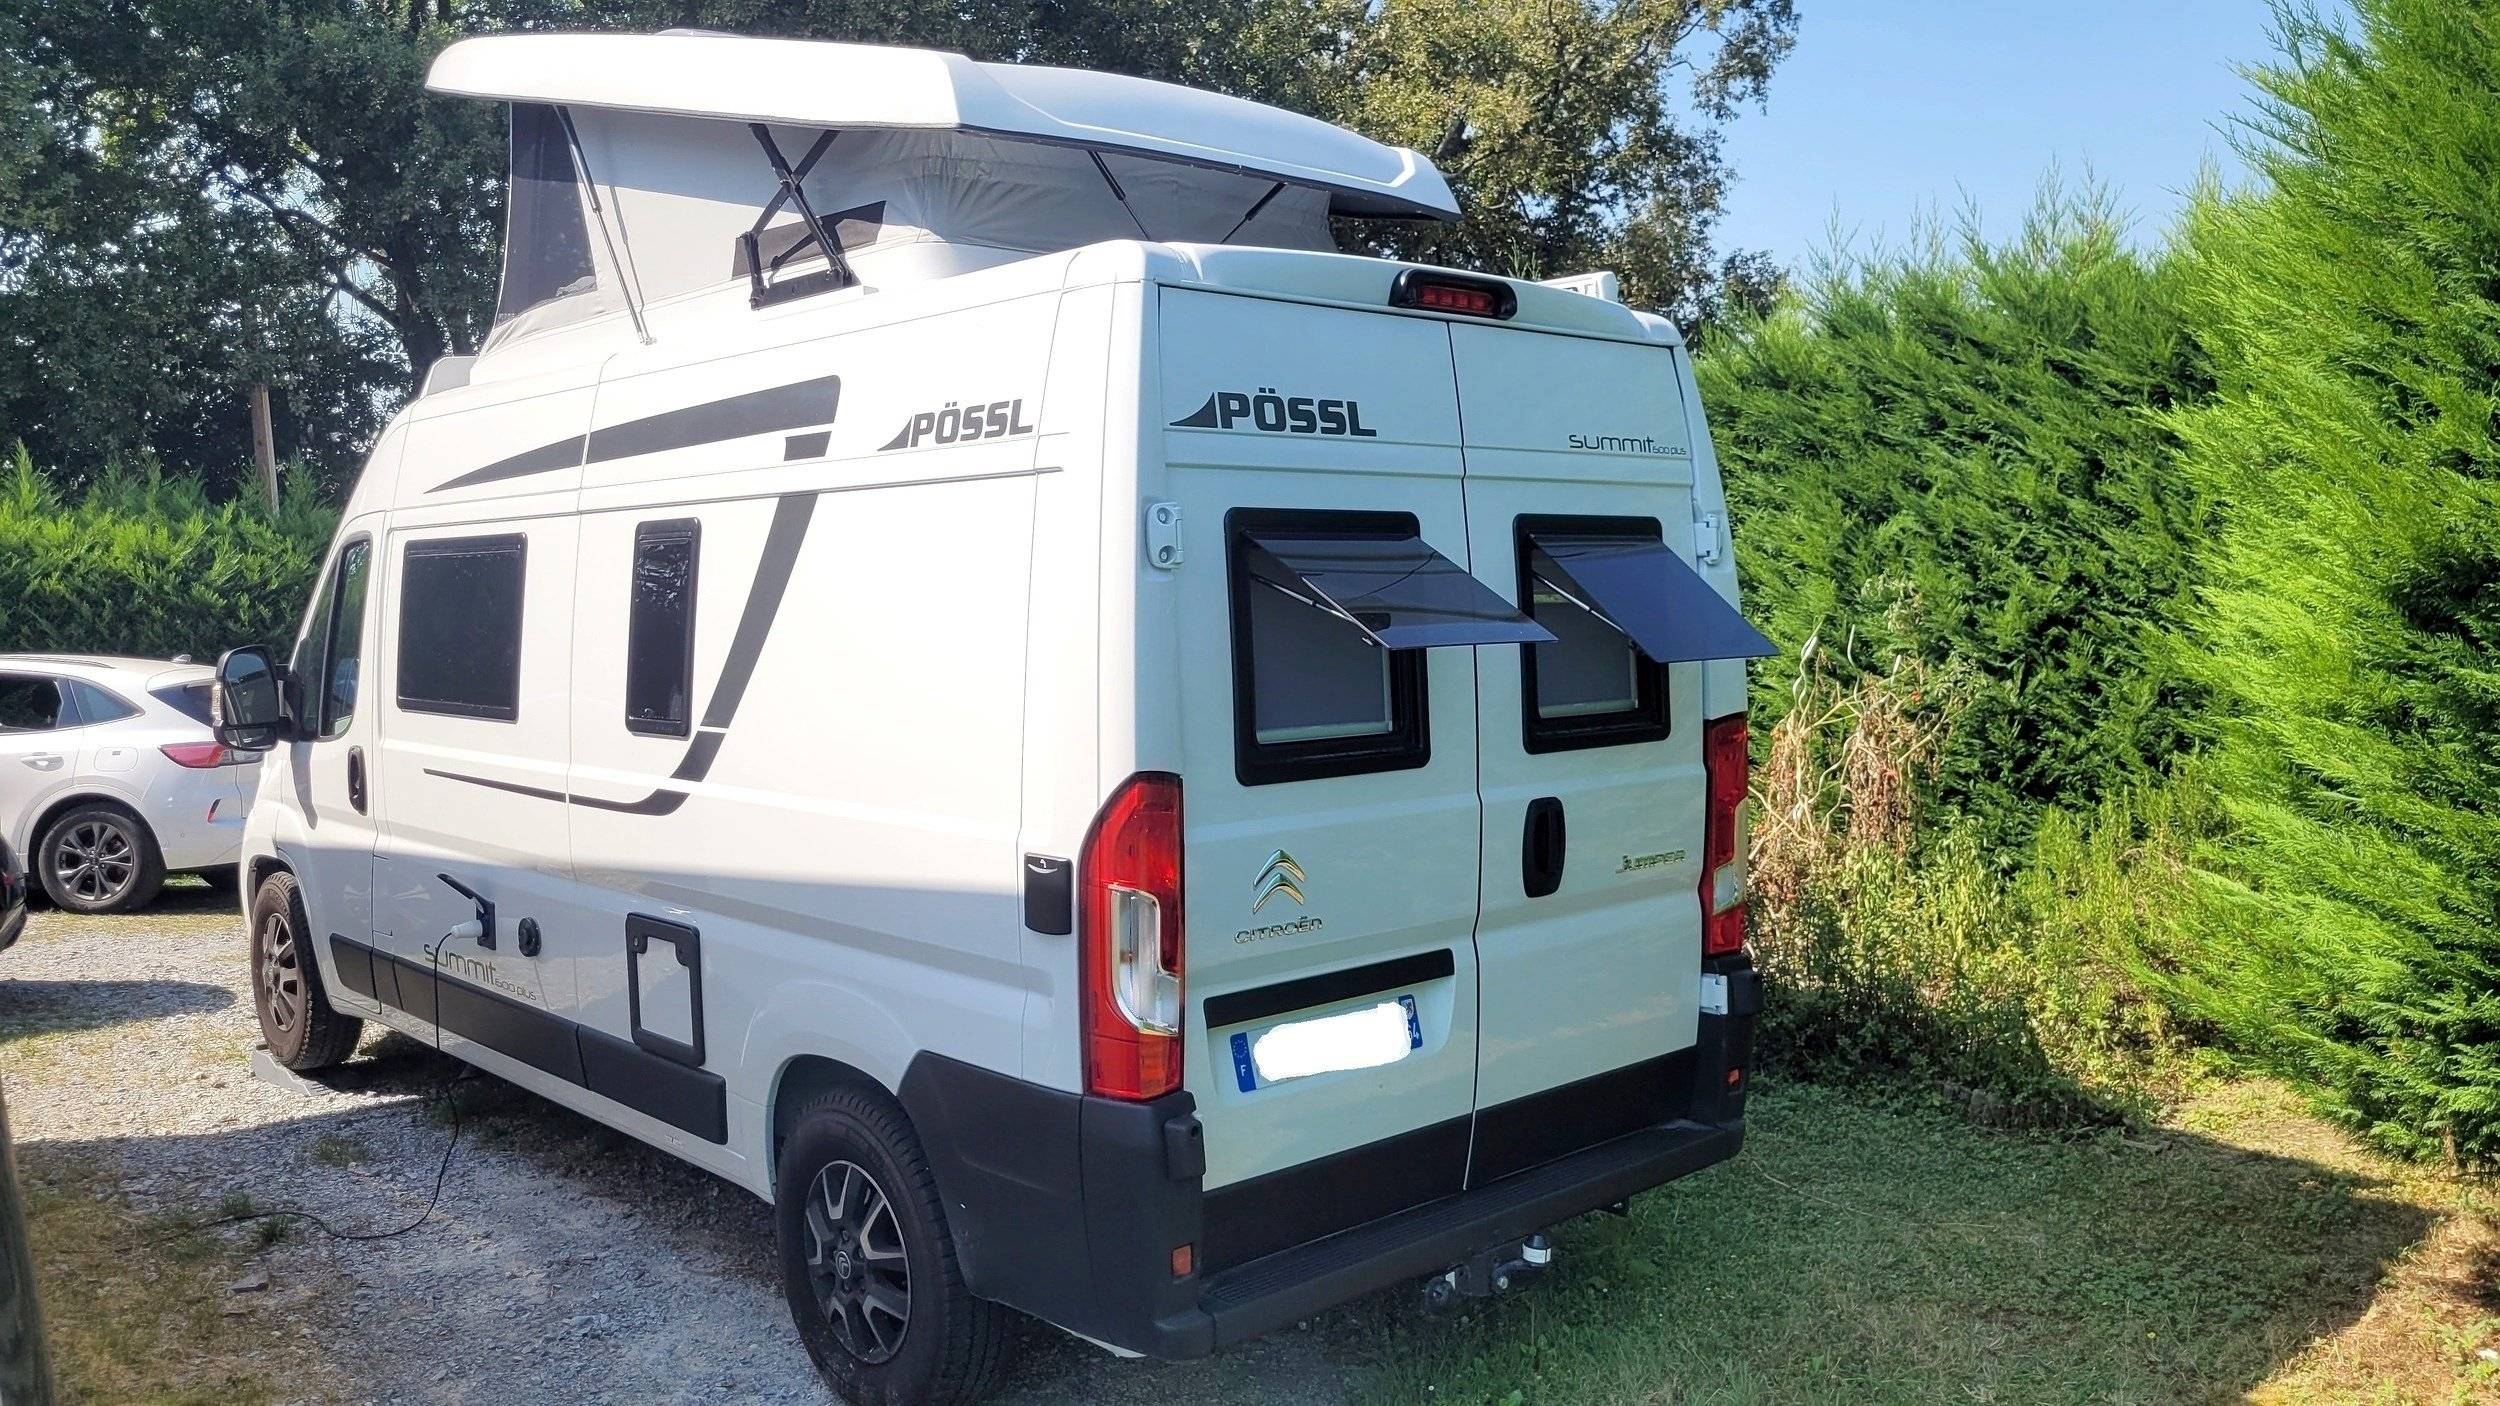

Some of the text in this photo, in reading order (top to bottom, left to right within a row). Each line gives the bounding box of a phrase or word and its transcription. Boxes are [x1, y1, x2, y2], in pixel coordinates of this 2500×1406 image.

[910, 399, 1034, 448] PÖSSL
[1217, 387, 1378, 438] PÖSSL
[1240, 1064, 1247, 1077] F
